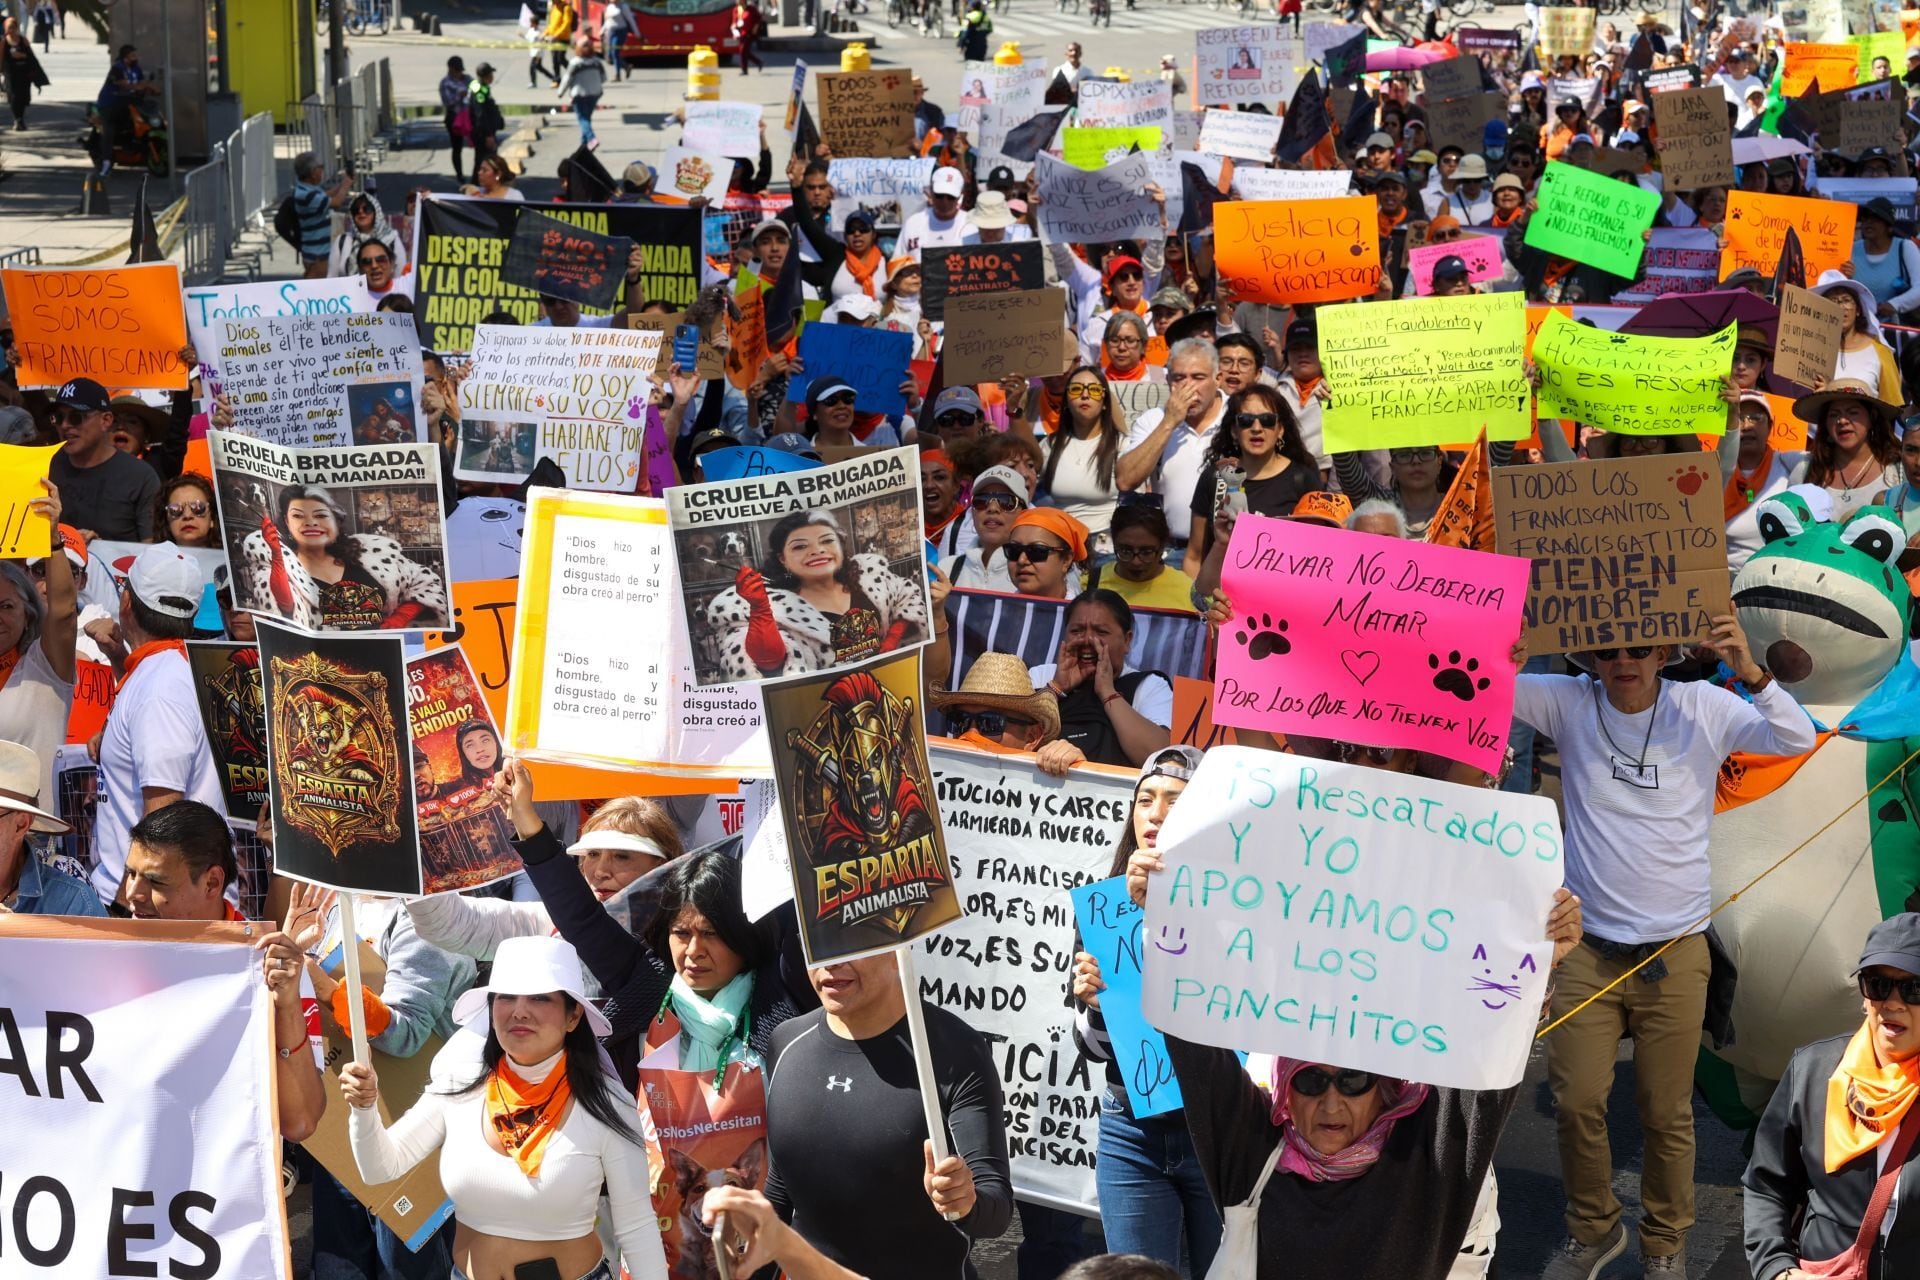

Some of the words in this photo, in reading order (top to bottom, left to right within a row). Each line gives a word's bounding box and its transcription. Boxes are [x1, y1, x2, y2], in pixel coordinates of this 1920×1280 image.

[823, 76, 877, 92] TODOS
[1081, 83, 1125, 99] CDMX
[827, 92, 874, 105] SOMOS
[823, 116, 900, 130] DEVUELVAN
[563, 236, 594, 254] NO
[969, 255, 1000, 269] NO
[25, 274, 129, 298] TODOS
[420, 266, 434, 292] Y
[437, 267, 459, 294] LA
[959, 282, 1010, 291] MALTRATO
[33, 305, 140, 332] SOMOS
[426, 296, 492, 322] AHORA
[1386, 316, 1470, 332] Fraudulenta
[221, 341, 271, 357] animales
[300, 333, 313, 348] te
[478, 327, 489, 345] Si
[494, 333, 527, 352] ignoras
[533, 336, 541, 344] su
[571, 333, 581, 346] YO
[583, 333, 591, 345] TE
[609, 333, 662, 348] RECUERDO
[1326, 335, 1387, 351] Asesina
[1558, 323, 1687, 358] RESCATE
[226, 361, 241, 376] Es
[245, 363, 258, 373] un
[264, 359, 283, 370] ser
[289, 354, 315, 368] vivo
[323, 354, 340, 371] que
[345, 343, 384, 359] siente
[390, 345, 408, 360] que
[475, 348, 485, 363] Si
[489, 354, 502, 364] no
[507, 353, 520, 366] los
[578, 353, 590, 366] YO
[592, 354, 601, 367] TE
[607, 355, 655, 370] TRADUZCO
[572, 374, 593, 396] YO
[601, 375, 635, 400] SOY
[1426, 386, 1447, 400] YA
[1457, 381, 1497, 396] PARA
[1540, 368, 1562, 387] NO
[1577, 373, 1613, 388] ES
[1633, 374, 1728, 393] RESCATE
[463, 384, 538, 412] SIEMPRE
[547, 393, 569, 414] SU
[578, 399, 625, 420] VOZ
[1585, 401, 1637, 413] RESCATE
[1670, 404, 1723, 414] MUEREN
[622, 427, 642, 453] POR
[223, 439, 293, 469] ¡CRUELA
[297, 450, 423, 469] BRUGADA
[227, 457, 287, 481] DEVUELVE
[290, 472, 301, 483] A
[304, 472, 326, 483] LA
[332, 468, 425, 483] MANADA!!
[684, 480, 789, 508] ¡CRUELA
[798, 456, 904, 494] BRUGADA
[1500, 470, 1577, 499] TODOS
[1593, 469, 1638, 496] LOS
[689, 500, 784, 523] DEVUELVE
[789, 499, 800, 511] A
[808, 494, 830, 508] LA
[834, 474, 906, 504] MANADA!!
[1510, 500, 1670, 531] FRANCISCANITOS
[1679, 498, 1693, 522] Y
[614, 540, 632, 552] hizo
[651, 545, 660, 555] al
[1510, 527, 1717, 557] FRANCISGATITOS
[564, 569, 621, 583] disgustado
[628, 575, 638, 585] de
[646, 579, 659, 588] su
[654, 563, 659, 573] y
[1236, 532, 1333, 582] SALVAR
[1390, 560, 1504, 610] DEBERIA
[1530, 552, 1677, 591] TIENEN
[563, 585, 588, 596] obra
[591, 587, 613, 599] creó
[616, 590, 624, 600] al
[324, 613, 381, 623] ESPARTA
[1323, 592, 1428, 641] MATAR
[1524, 588, 1664, 628] NOMBRE
[1688, 589, 1701, 607] E
[1559, 610, 1713, 648] HISTORIA
[836, 638, 880, 661] ESPARTA
[410, 669, 424, 681] ES
[683, 698, 756, 711] disgustado
[1219, 678, 1262, 712] POR
[1266, 687, 1304, 712] LOS
[1308, 692, 1347, 719] QUE
[1386, 703, 1458, 732] TIENEN
[1468, 718, 1499, 751] VOZ
[683, 715, 712, 725] obra
[717, 715, 745, 725] creó
[750, 715, 761, 725] al
[297, 775, 370, 808] ESPARTA
[303, 793, 364, 812] ANIMALISTA
[459, 788, 476, 800] 100K
[426, 802, 439, 811] 10K
[1040, 822, 1112, 847] RIVERO.
[1229, 823, 1250, 864] Y
[1300, 824, 1360, 874] YO
[812, 831, 944, 919] ESPARTA
[842, 882, 929, 924] ANIMALISTA
[1170, 864, 1455, 952] APOYAMOS
[1031, 942, 1069, 972] SU
[1227, 928, 1253, 961] A
[1294, 941, 1377, 981] LOS
[919, 975, 1026, 1011] MANDO
[1041, 1116, 1084, 1142] DEL
[107, 1187, 221, 1280] ES
